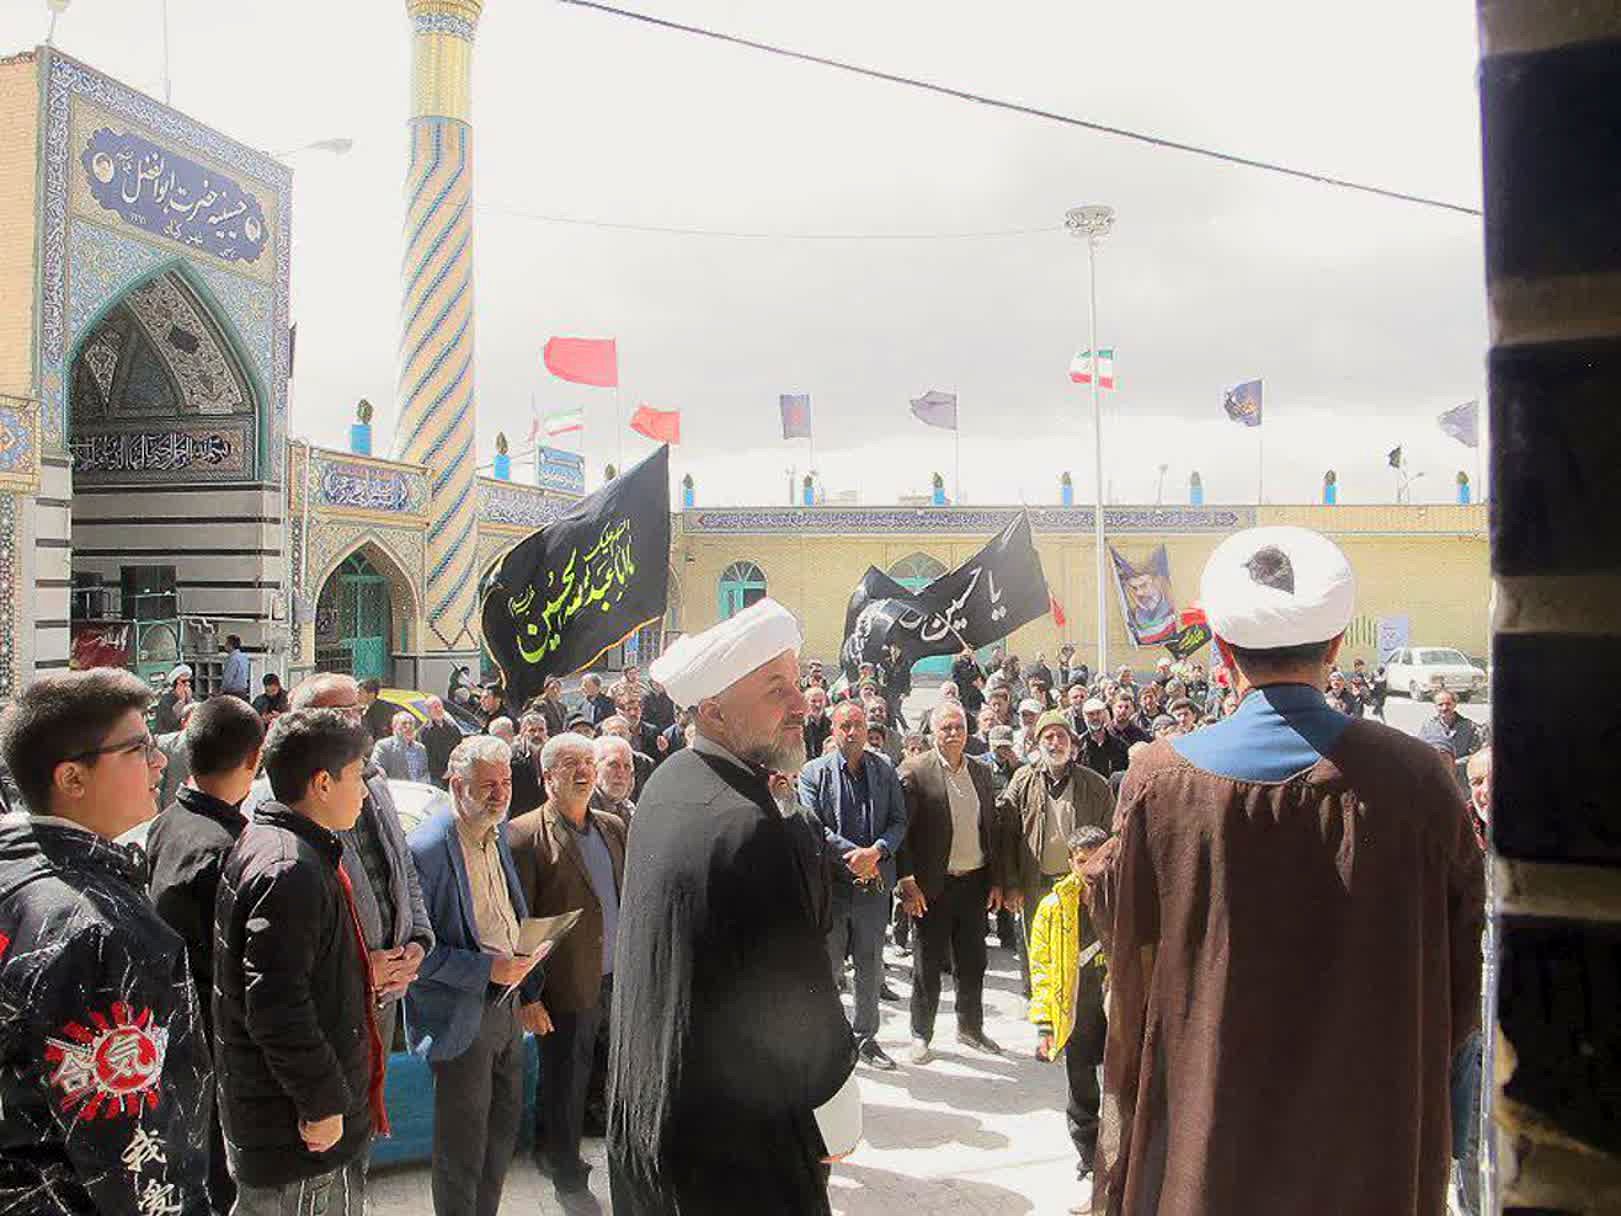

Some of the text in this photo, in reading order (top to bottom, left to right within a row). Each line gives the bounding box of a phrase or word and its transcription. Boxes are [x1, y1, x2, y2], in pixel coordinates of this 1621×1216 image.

[168, 167, 219, 221] حضرت
[921, 565, 983, 641] حسین
[987, 568, 1009, 622] یا
